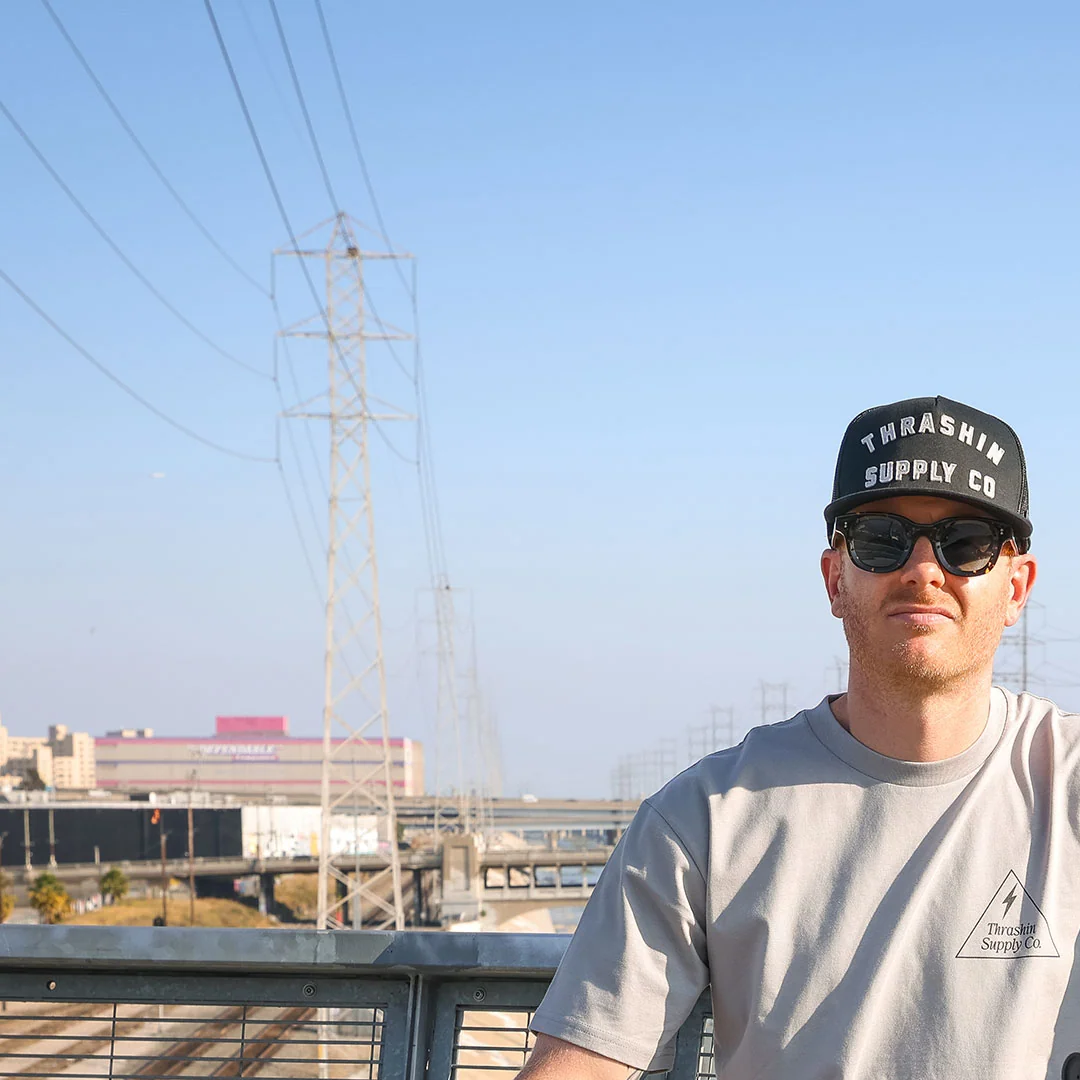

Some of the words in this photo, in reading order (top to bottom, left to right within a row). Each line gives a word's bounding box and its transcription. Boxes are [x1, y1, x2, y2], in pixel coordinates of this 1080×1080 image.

[861, 412, 1006, 466] THRASHIN
[864, 459, 958, 488] SUPPLY
[968, 469, 997, 499] CO
[987, 922, 1036, 936] Thrashin
[981, 937, 1022, 953] Supply
[1024, 936, 1042, 949] Co.
